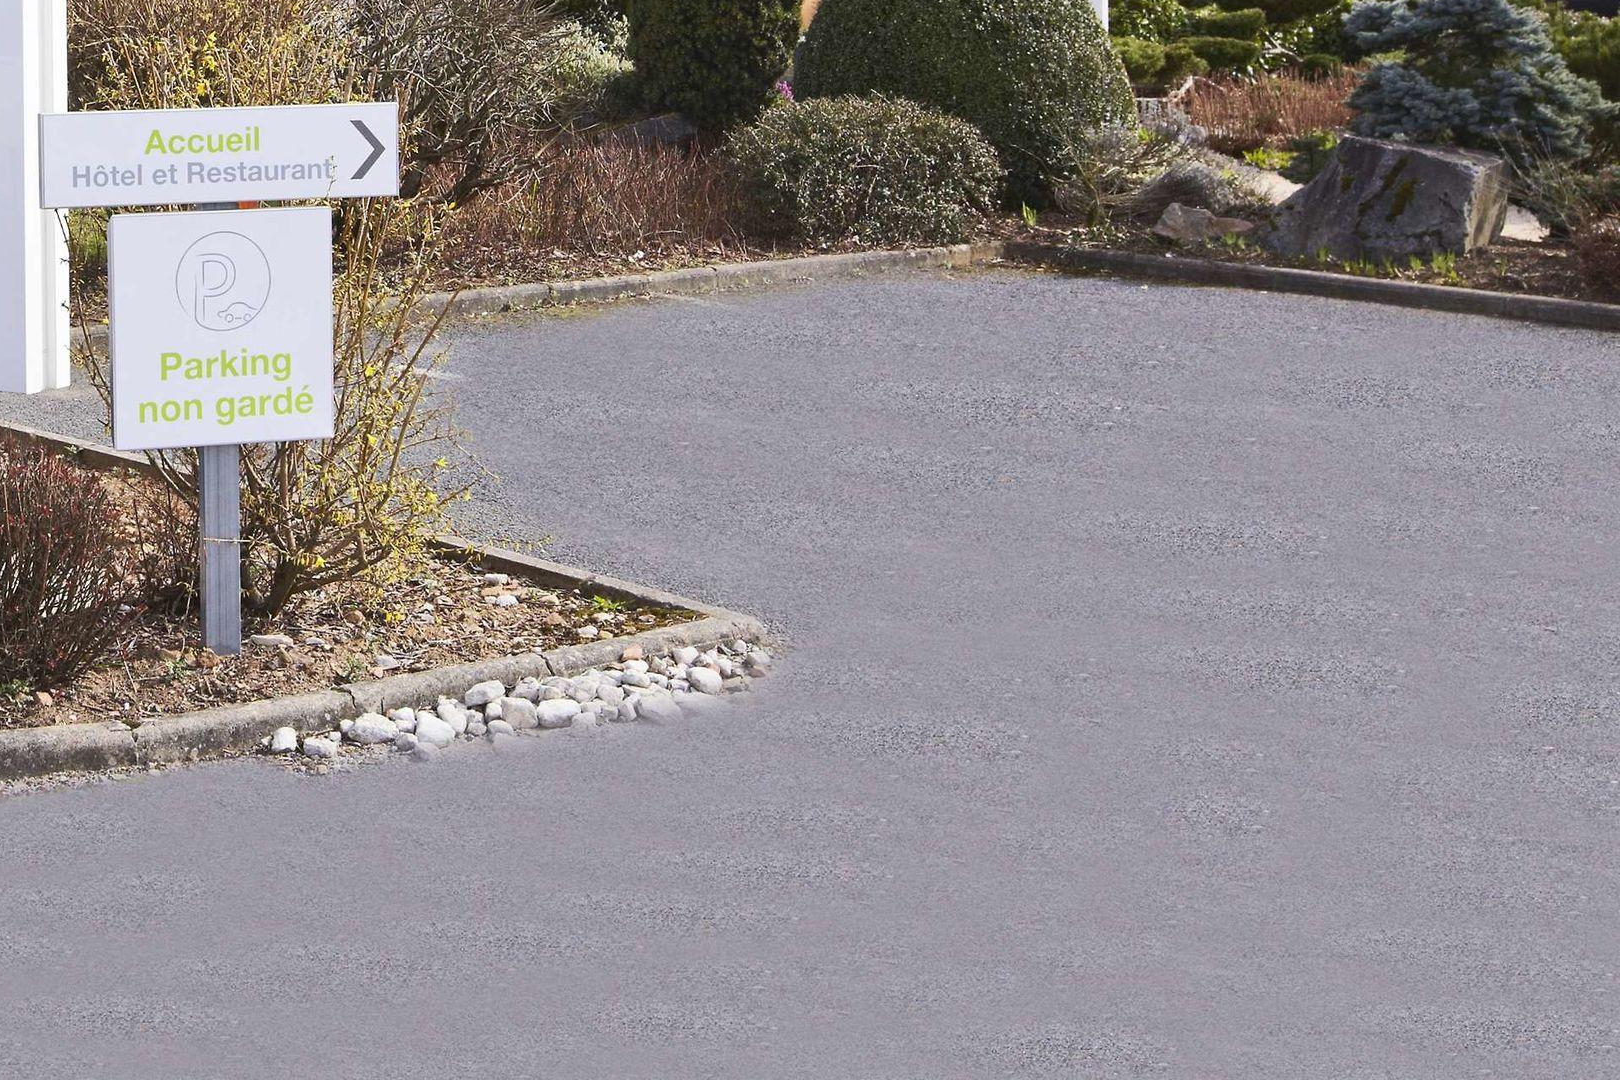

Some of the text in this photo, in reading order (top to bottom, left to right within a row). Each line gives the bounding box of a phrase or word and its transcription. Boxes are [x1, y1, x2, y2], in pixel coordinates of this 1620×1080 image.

[143, 126, 261, 156] Accueil
[72, 157, 334, 188] Hôtel et Restaurant
[159, 347, 293, 381] Parking
[138, 384, 314, 426] non gardé
